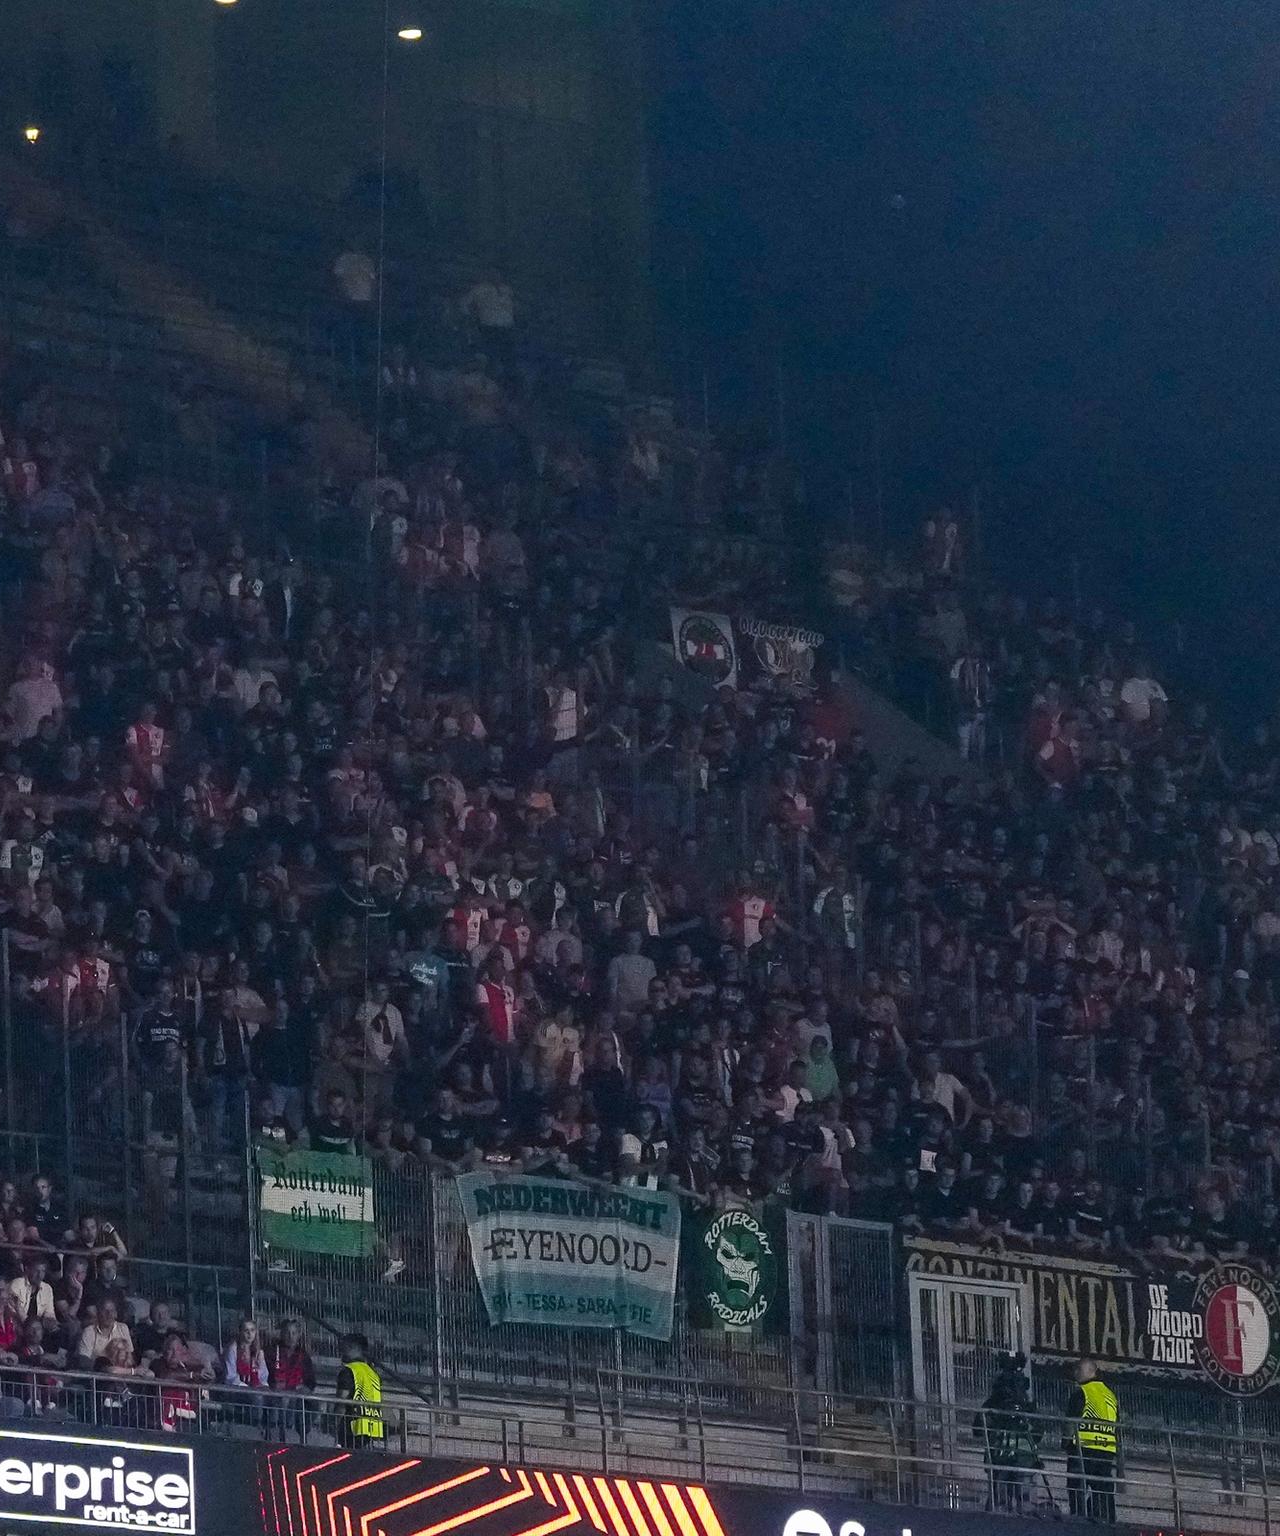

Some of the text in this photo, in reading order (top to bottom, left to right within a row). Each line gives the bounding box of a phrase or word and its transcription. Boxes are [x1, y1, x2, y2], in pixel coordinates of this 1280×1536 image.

[271, 1160, 365, 1197] Rotterdam
[704, 1211, 772, 1255] ROTTERDAM
[525, 1293, 566, 1311] TESSA
[577, 1297, 617, 1315] SARA
[707, 1291, 768, 1325] RADICALS
[906, 1252, 1145, 1360] CONTINENTAL
[1148, 1283, 1168, 1310] DE
[1197, 1268, 1277, 1316] FEYENOORD
[1147, 1308, 1203, 1339] NOORD
[1151, 1335, 1196, 1365] ZIJDE
[1201, 1353, 1278, 1392] ROTTERDAM
[83, 1502, 190, 1529] rent-a-car
